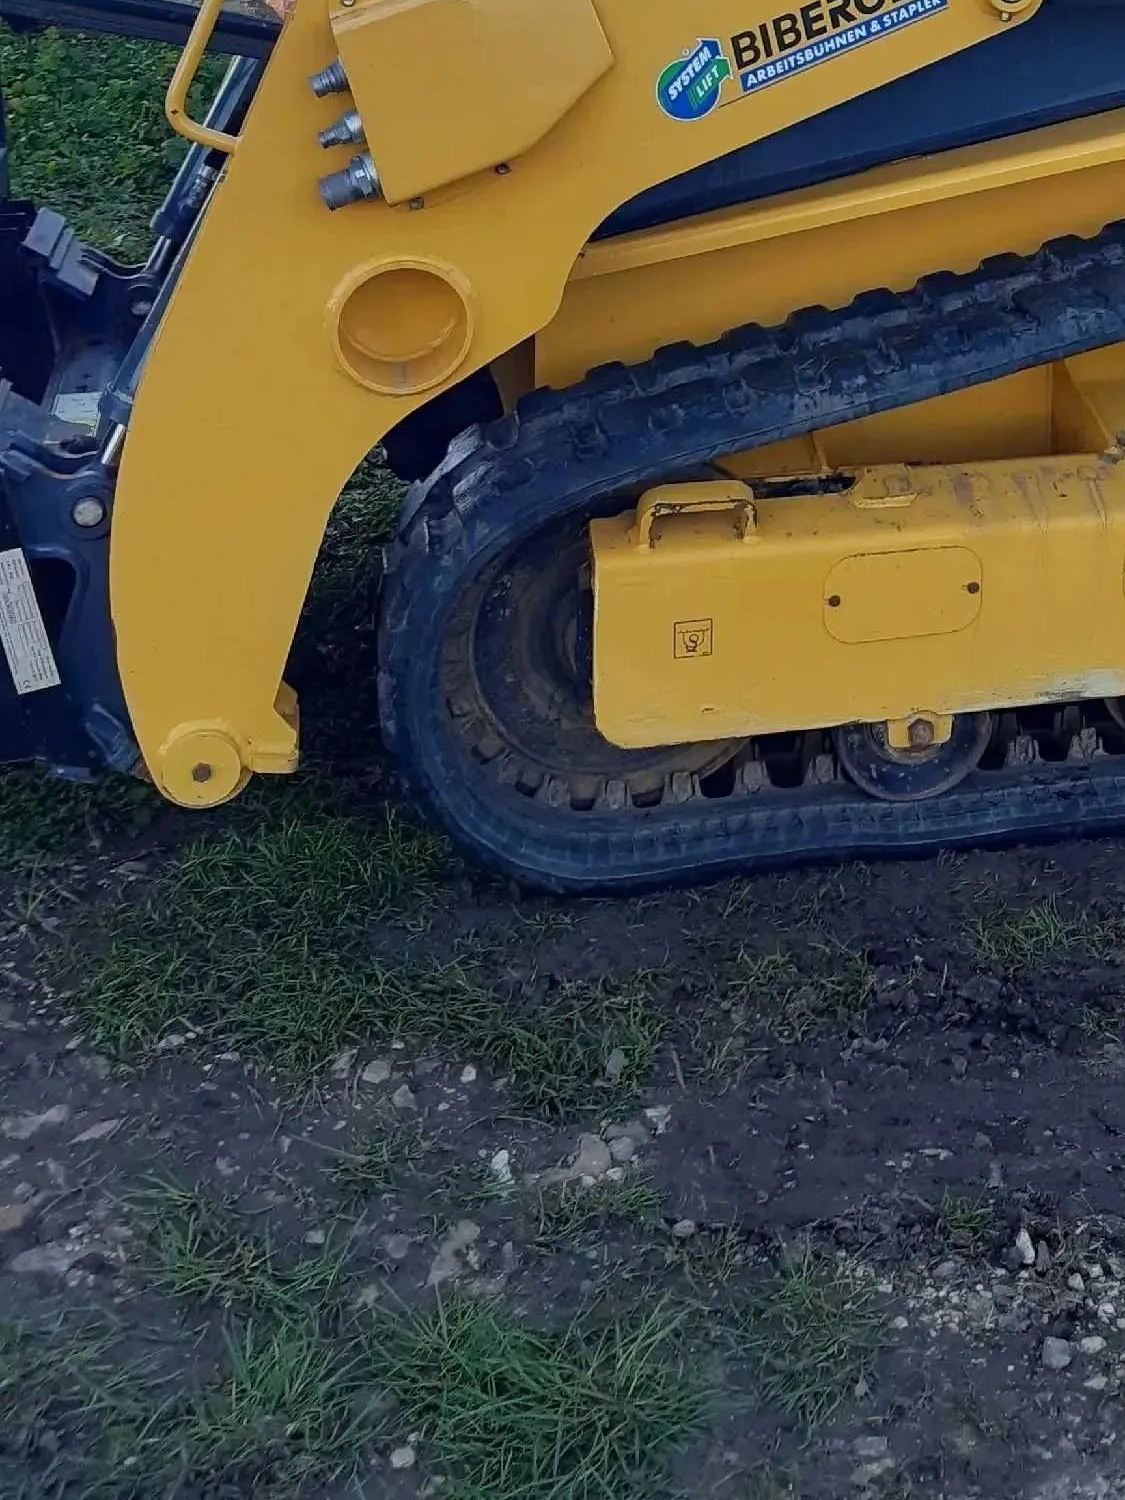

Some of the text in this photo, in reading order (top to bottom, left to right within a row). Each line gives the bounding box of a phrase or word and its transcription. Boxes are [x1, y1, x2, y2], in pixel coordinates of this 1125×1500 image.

[870, 19, 882, 33] &
[668, 46, 712, 100] SYSTEM
[696, 65, 719, 97] LIFT
